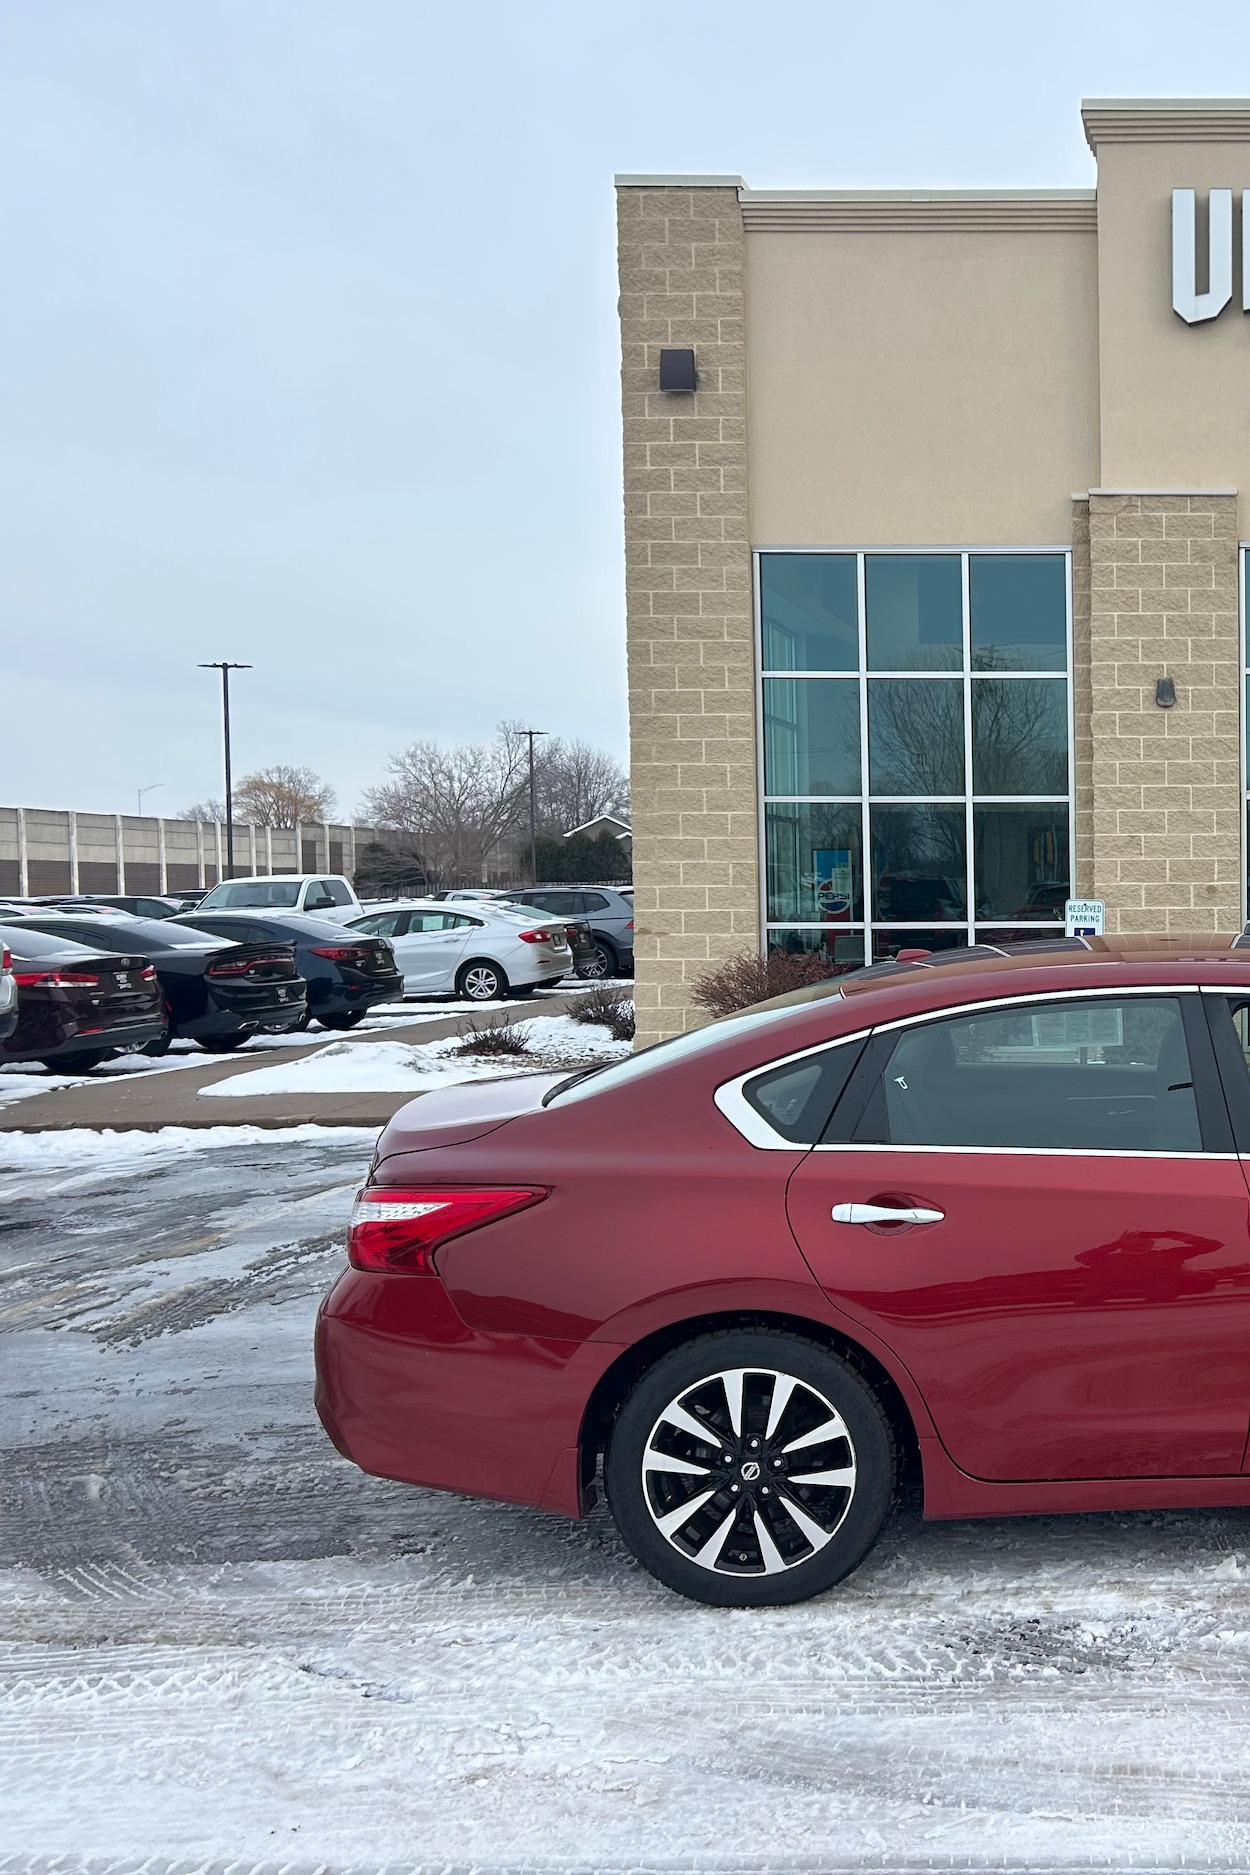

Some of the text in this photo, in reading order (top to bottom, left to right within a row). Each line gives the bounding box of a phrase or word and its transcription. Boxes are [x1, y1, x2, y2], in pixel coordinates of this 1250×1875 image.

[818, 892, 850, 900] PEPSI
[1068, 904, 1102, 913] RESERVED
[1070, 914, 1100, 923] PARKING
